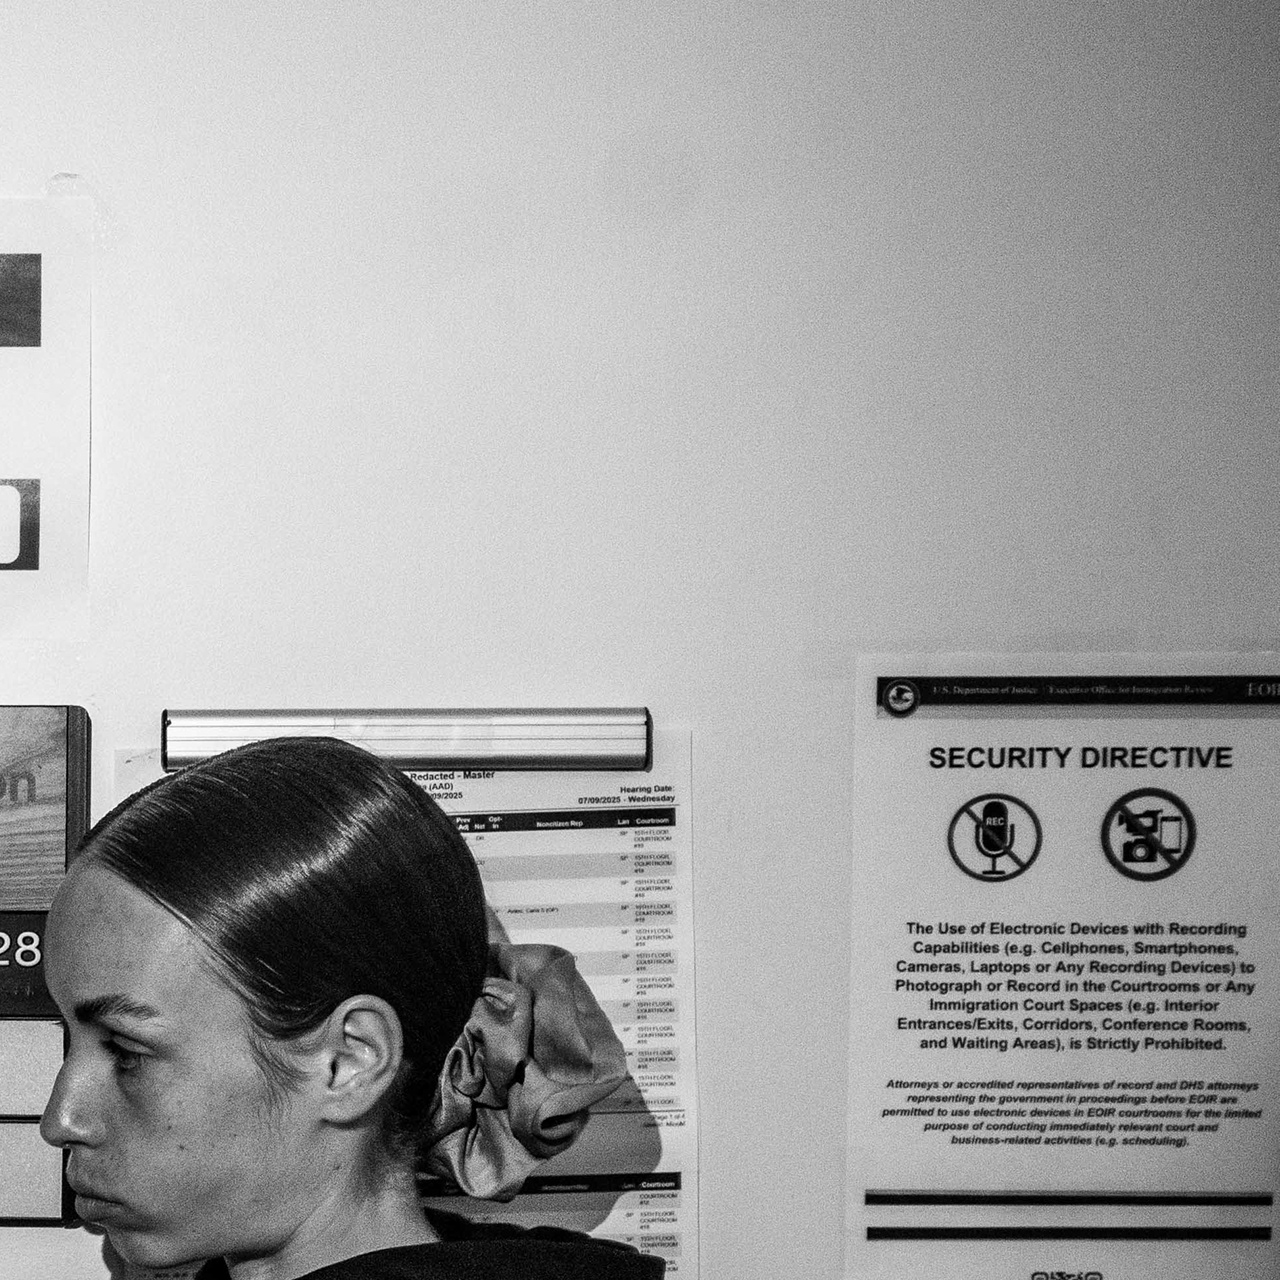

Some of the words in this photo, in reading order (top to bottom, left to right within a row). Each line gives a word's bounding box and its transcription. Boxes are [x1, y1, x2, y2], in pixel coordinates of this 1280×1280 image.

[1247, 682, 1280, 697] EOI
[929, 746, 1072, 768] SECURITY
[1080, 746, 1232, 768] DIRECTIVE
[410, 772, 455, 781] Redacted
[463, 771, 495, 780] Master
[429, 783, 453, 791] (AAD)
[620, 786, 651, 795] Hearing
[653, 785, 675, 793] Date:
[578, 796, 621, 804] 07/09/2025
[628, 795, 675, 804] Wednesday
[986, 817, 1004, 826] REC
[906, 921, 933, 934] The
[938, 922, 966, 934] Use
[970, 922, 986, 934] of
[989, 922, 1065, 934] Electronic
[1070, 922, 1128, 935] Devices
[1132, 922, 1164, 935] with
[1168, 922, 1246, 938] Recording
[912, 940, 1000, 956] Capabilities
[1004, 941, 1036, 957] (e.g.
[1040, 941, 1128, 956] Cellphones,
[1133, 941, 1238, 956] Smartphones,
[896, 959, 965, 974] Cameras,
[970, 960, 1030, 975] Laptops
[1035, 963, 1051, 973] or
[1054, 960, 1084, 976] Any
[1089, 960, 1166, 976] Recording
[1170, 960, 1236, 976] Devices)
[1239, 962, 1255, 973] to
[895, 978, 982, 995] Photograph
[986, 982, 1002, 992] or
[1006, 978, 1060, 992] Record
[1064, 980, 1078, 992] in
[1082, 979, 1106, 992] the
[1110, 979, 1200, 992] Courtrooms
[1204, 982, 1221, 992] or
[1224, 980, 1255, 995] Any
[929, 998, 1018, 1014] Immigration
[1022, 998, 1064, 1011] Court
[1068, 998, 1123, 1014] Spaces
[1127, 998, 1159, 1014] (e.g.
[1164, 998, 1220, 1012] Interior
[897, 1016, 1018, 1032] Entrances/Exits,
[1022, 1017, 1096, 1032] Corridors,
[1101, 1017, 1188, 1030] Conference
[1192, 1018, 1250, 1032] Rooms,
[919, 1036, 947, 1049] and
[951, 1036, 1008, 1052] Waiting
[1012, 1036, 1064, 1052] Areas),
[1069, 1037, 1082, 1049] is
[1086, 1036, 1140, 1052] Strictly
[1144, 1036, 1226, 1050] Prohibited.
